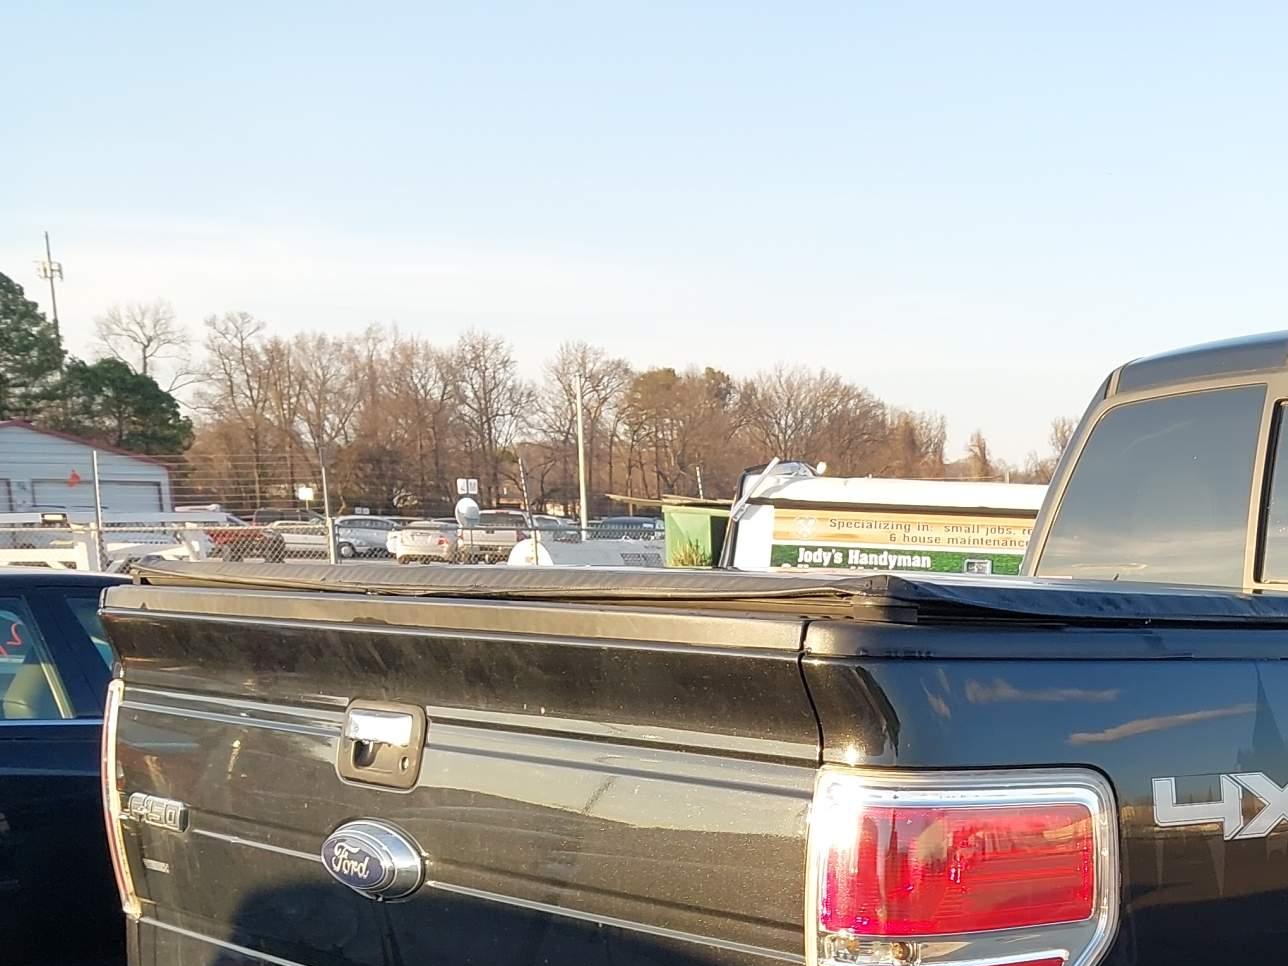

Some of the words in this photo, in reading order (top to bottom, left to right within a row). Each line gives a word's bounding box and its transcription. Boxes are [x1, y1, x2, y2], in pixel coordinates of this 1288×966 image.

[829, 518, 911, 533] Specializing
[944, 523, 980, 534] small
[903, 533, 941, 544] house
[798, 547, 843, 567] Jody's
[848, 548, 932, 571] Handyman
[331, 842, 370, 879] Ford
